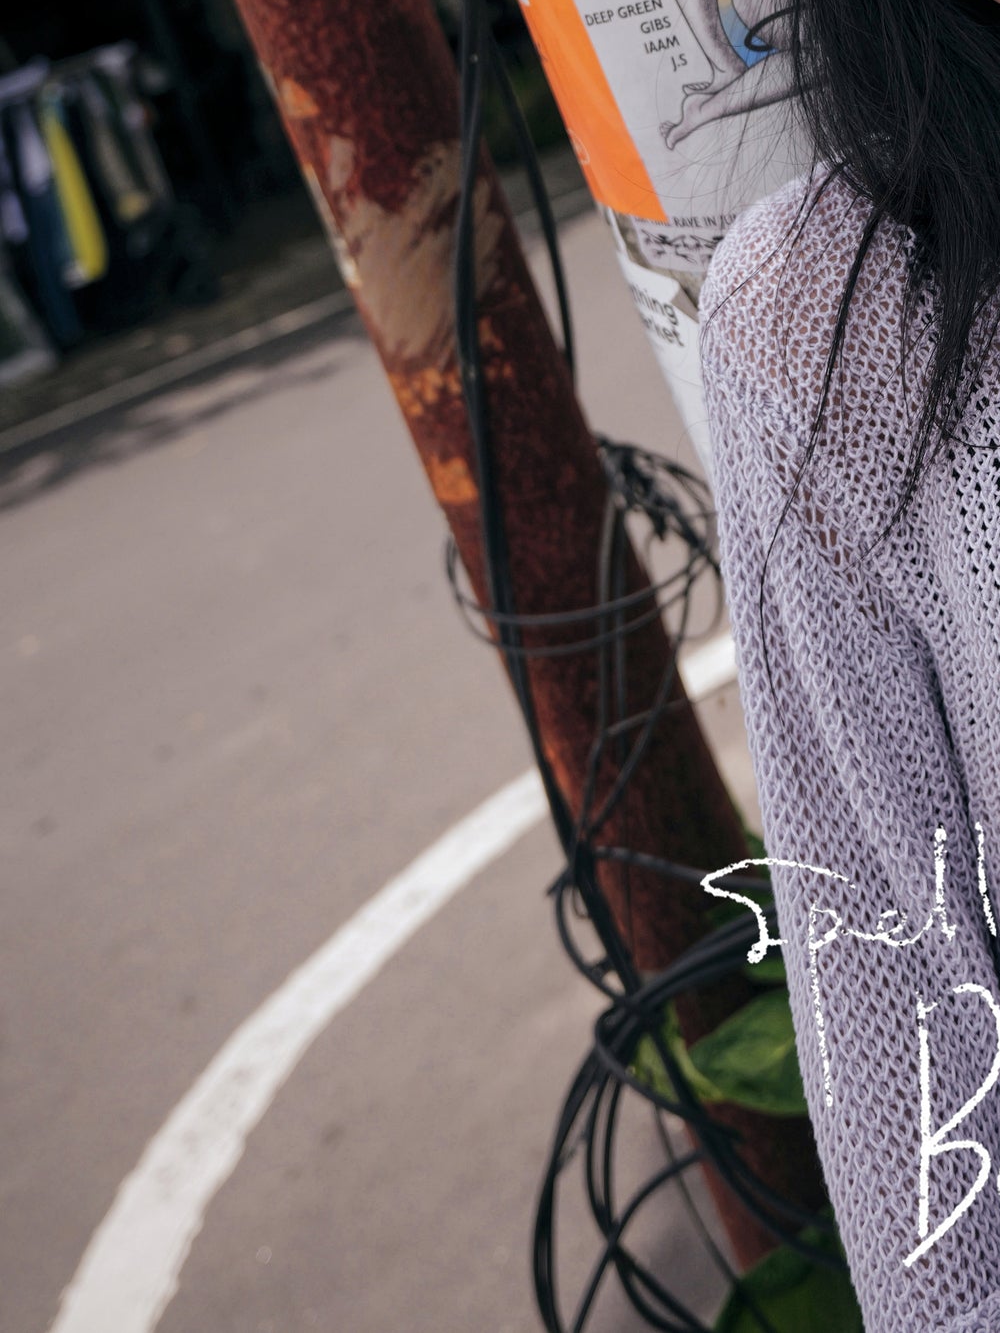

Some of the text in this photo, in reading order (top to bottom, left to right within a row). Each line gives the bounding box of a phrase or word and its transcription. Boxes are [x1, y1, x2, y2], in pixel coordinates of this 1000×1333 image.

[585, 9, 615, 26] DEEP
[640, 16, 672, 34] GIBS
[644, 34, 680, 54] IAAM
[674, 216, 703, 227] RAVE
